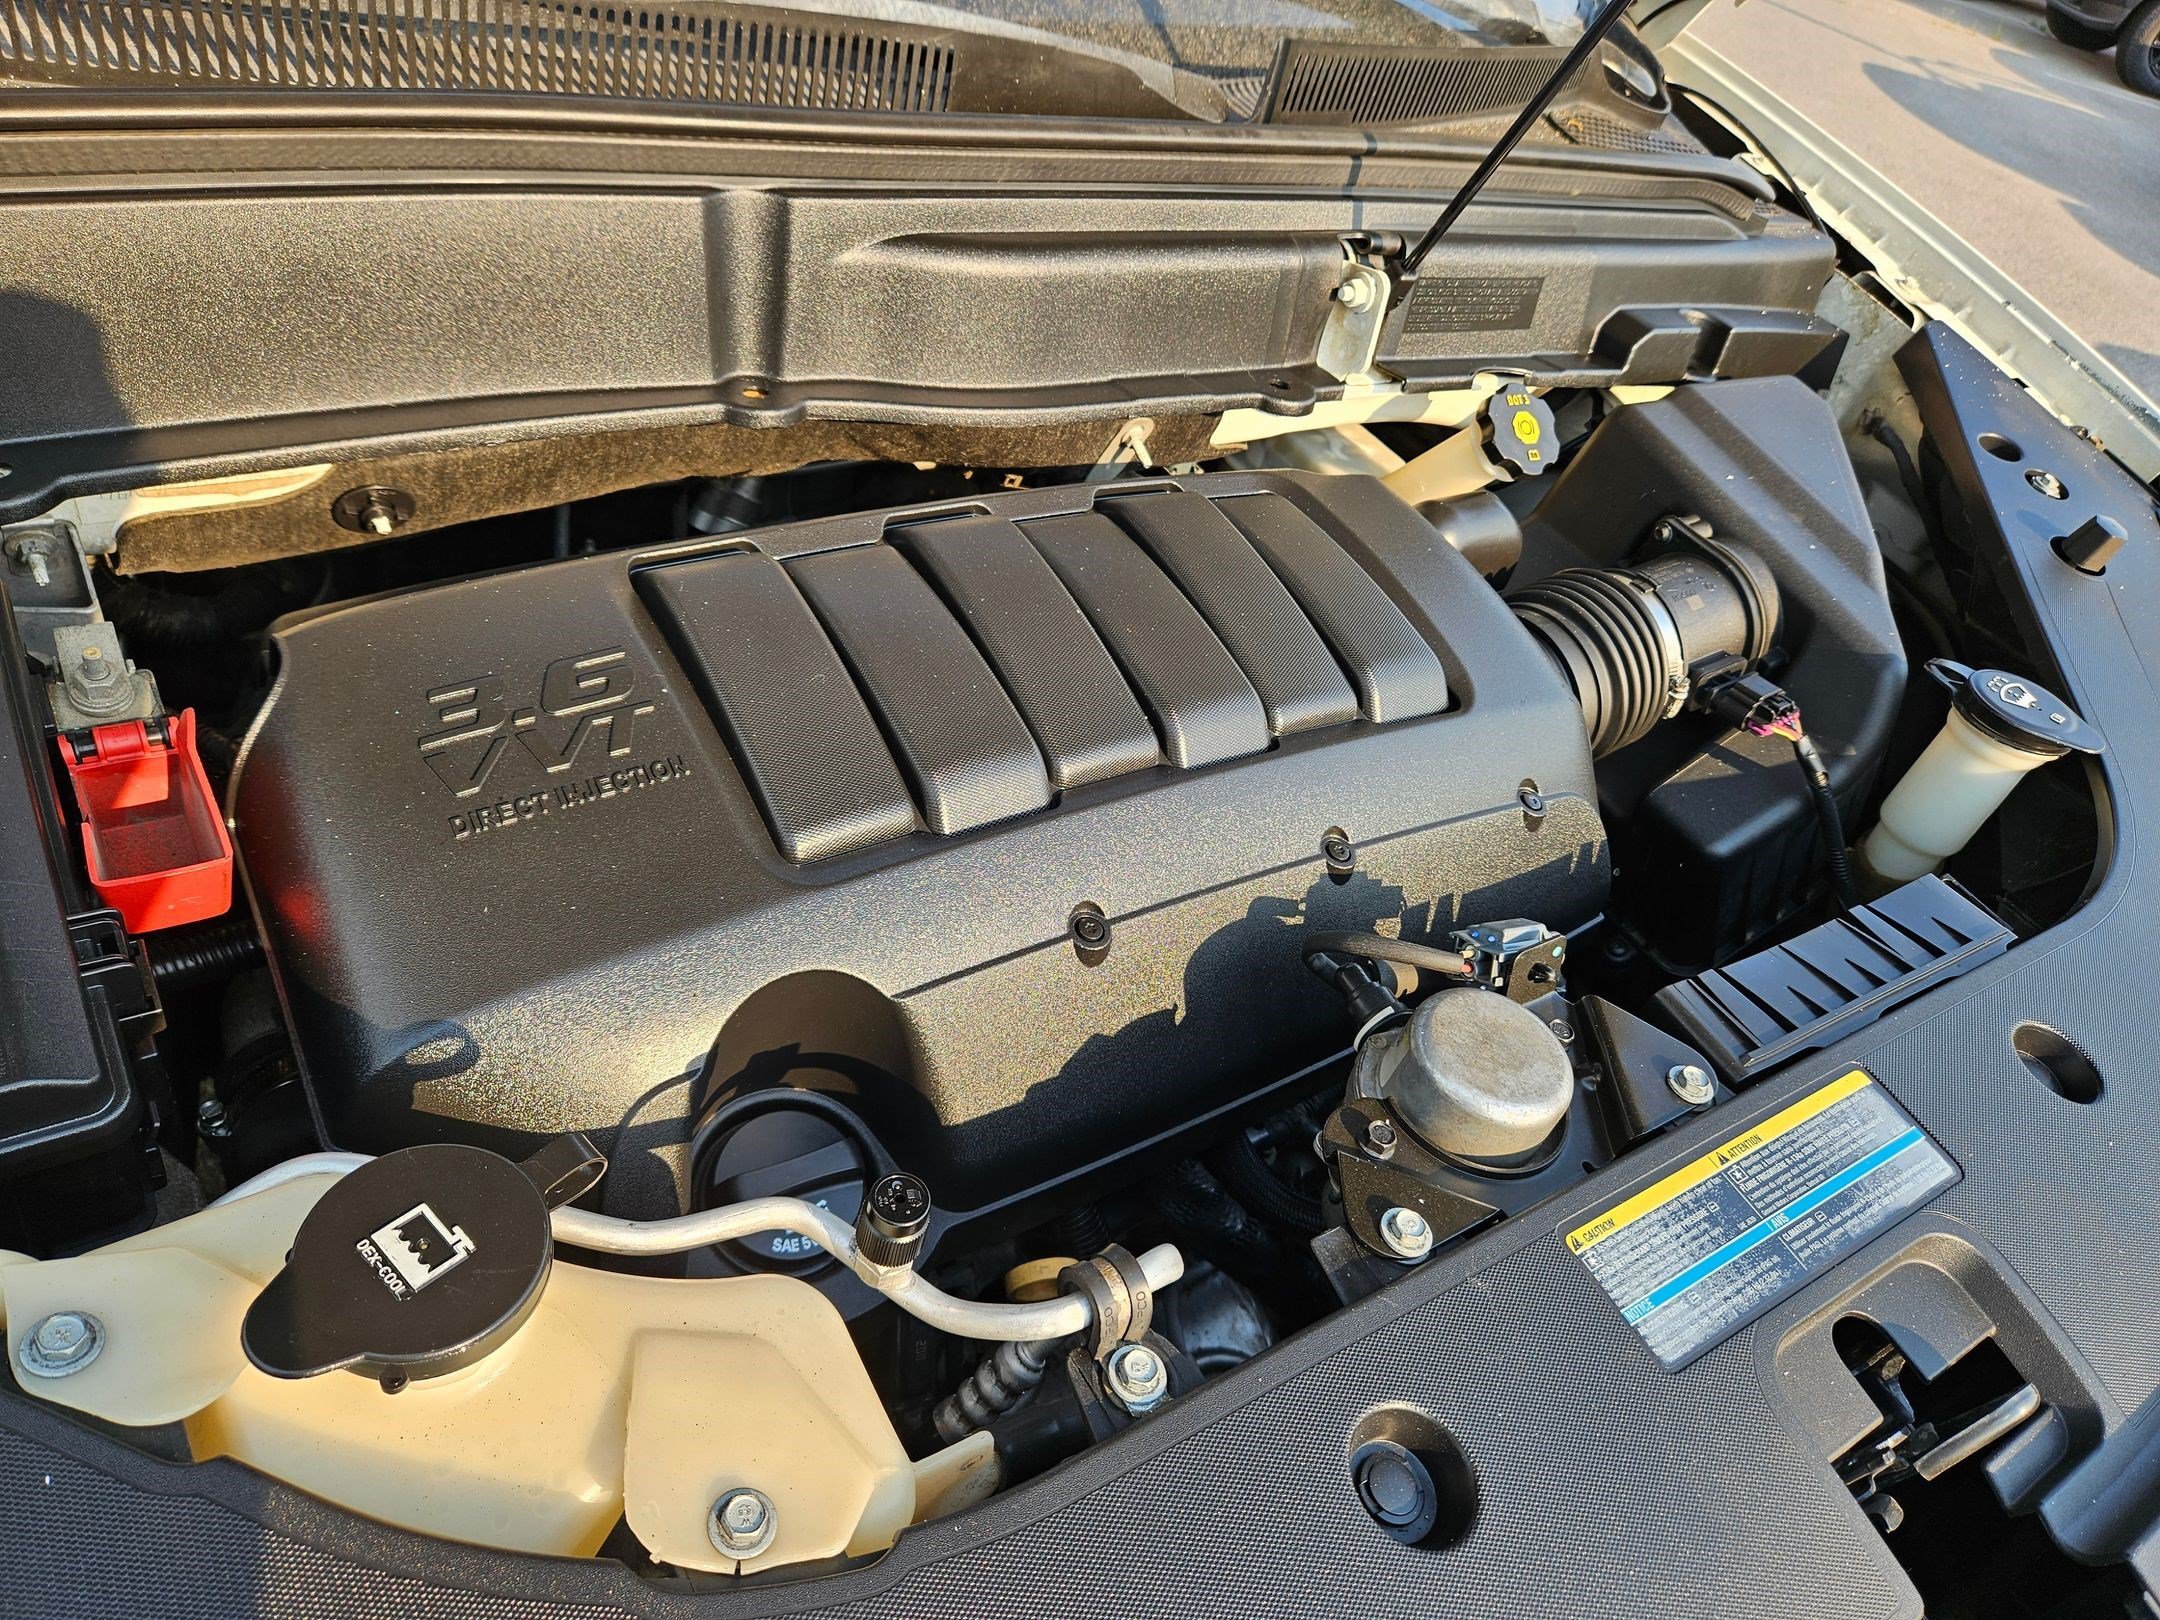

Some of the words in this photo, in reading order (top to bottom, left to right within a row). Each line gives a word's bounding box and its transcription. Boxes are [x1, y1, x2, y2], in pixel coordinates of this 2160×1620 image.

[1506, 394, 1523, 406] DOT
[1523, 394, 1530, 405] 3
[417, 645, 635, 752] 3.6
[447, 789, 550, 840] DIRECT
[553, 754, 691, 810] INJECTION
[1725, 1133, 1763, 1159] ATTENTION
[1581, 1217, 1616, 1242] CAUTION
[1769, 1212, 1790, 1229] AVIS
[1781, 1216, 1816, 1241] CLIMATISEUR
[771, 1237, 800, 1253] SAE
[355, 1237, 414, 1302] DEX-COOL
[1623, 1297, 1655, 1321] NOTICE
